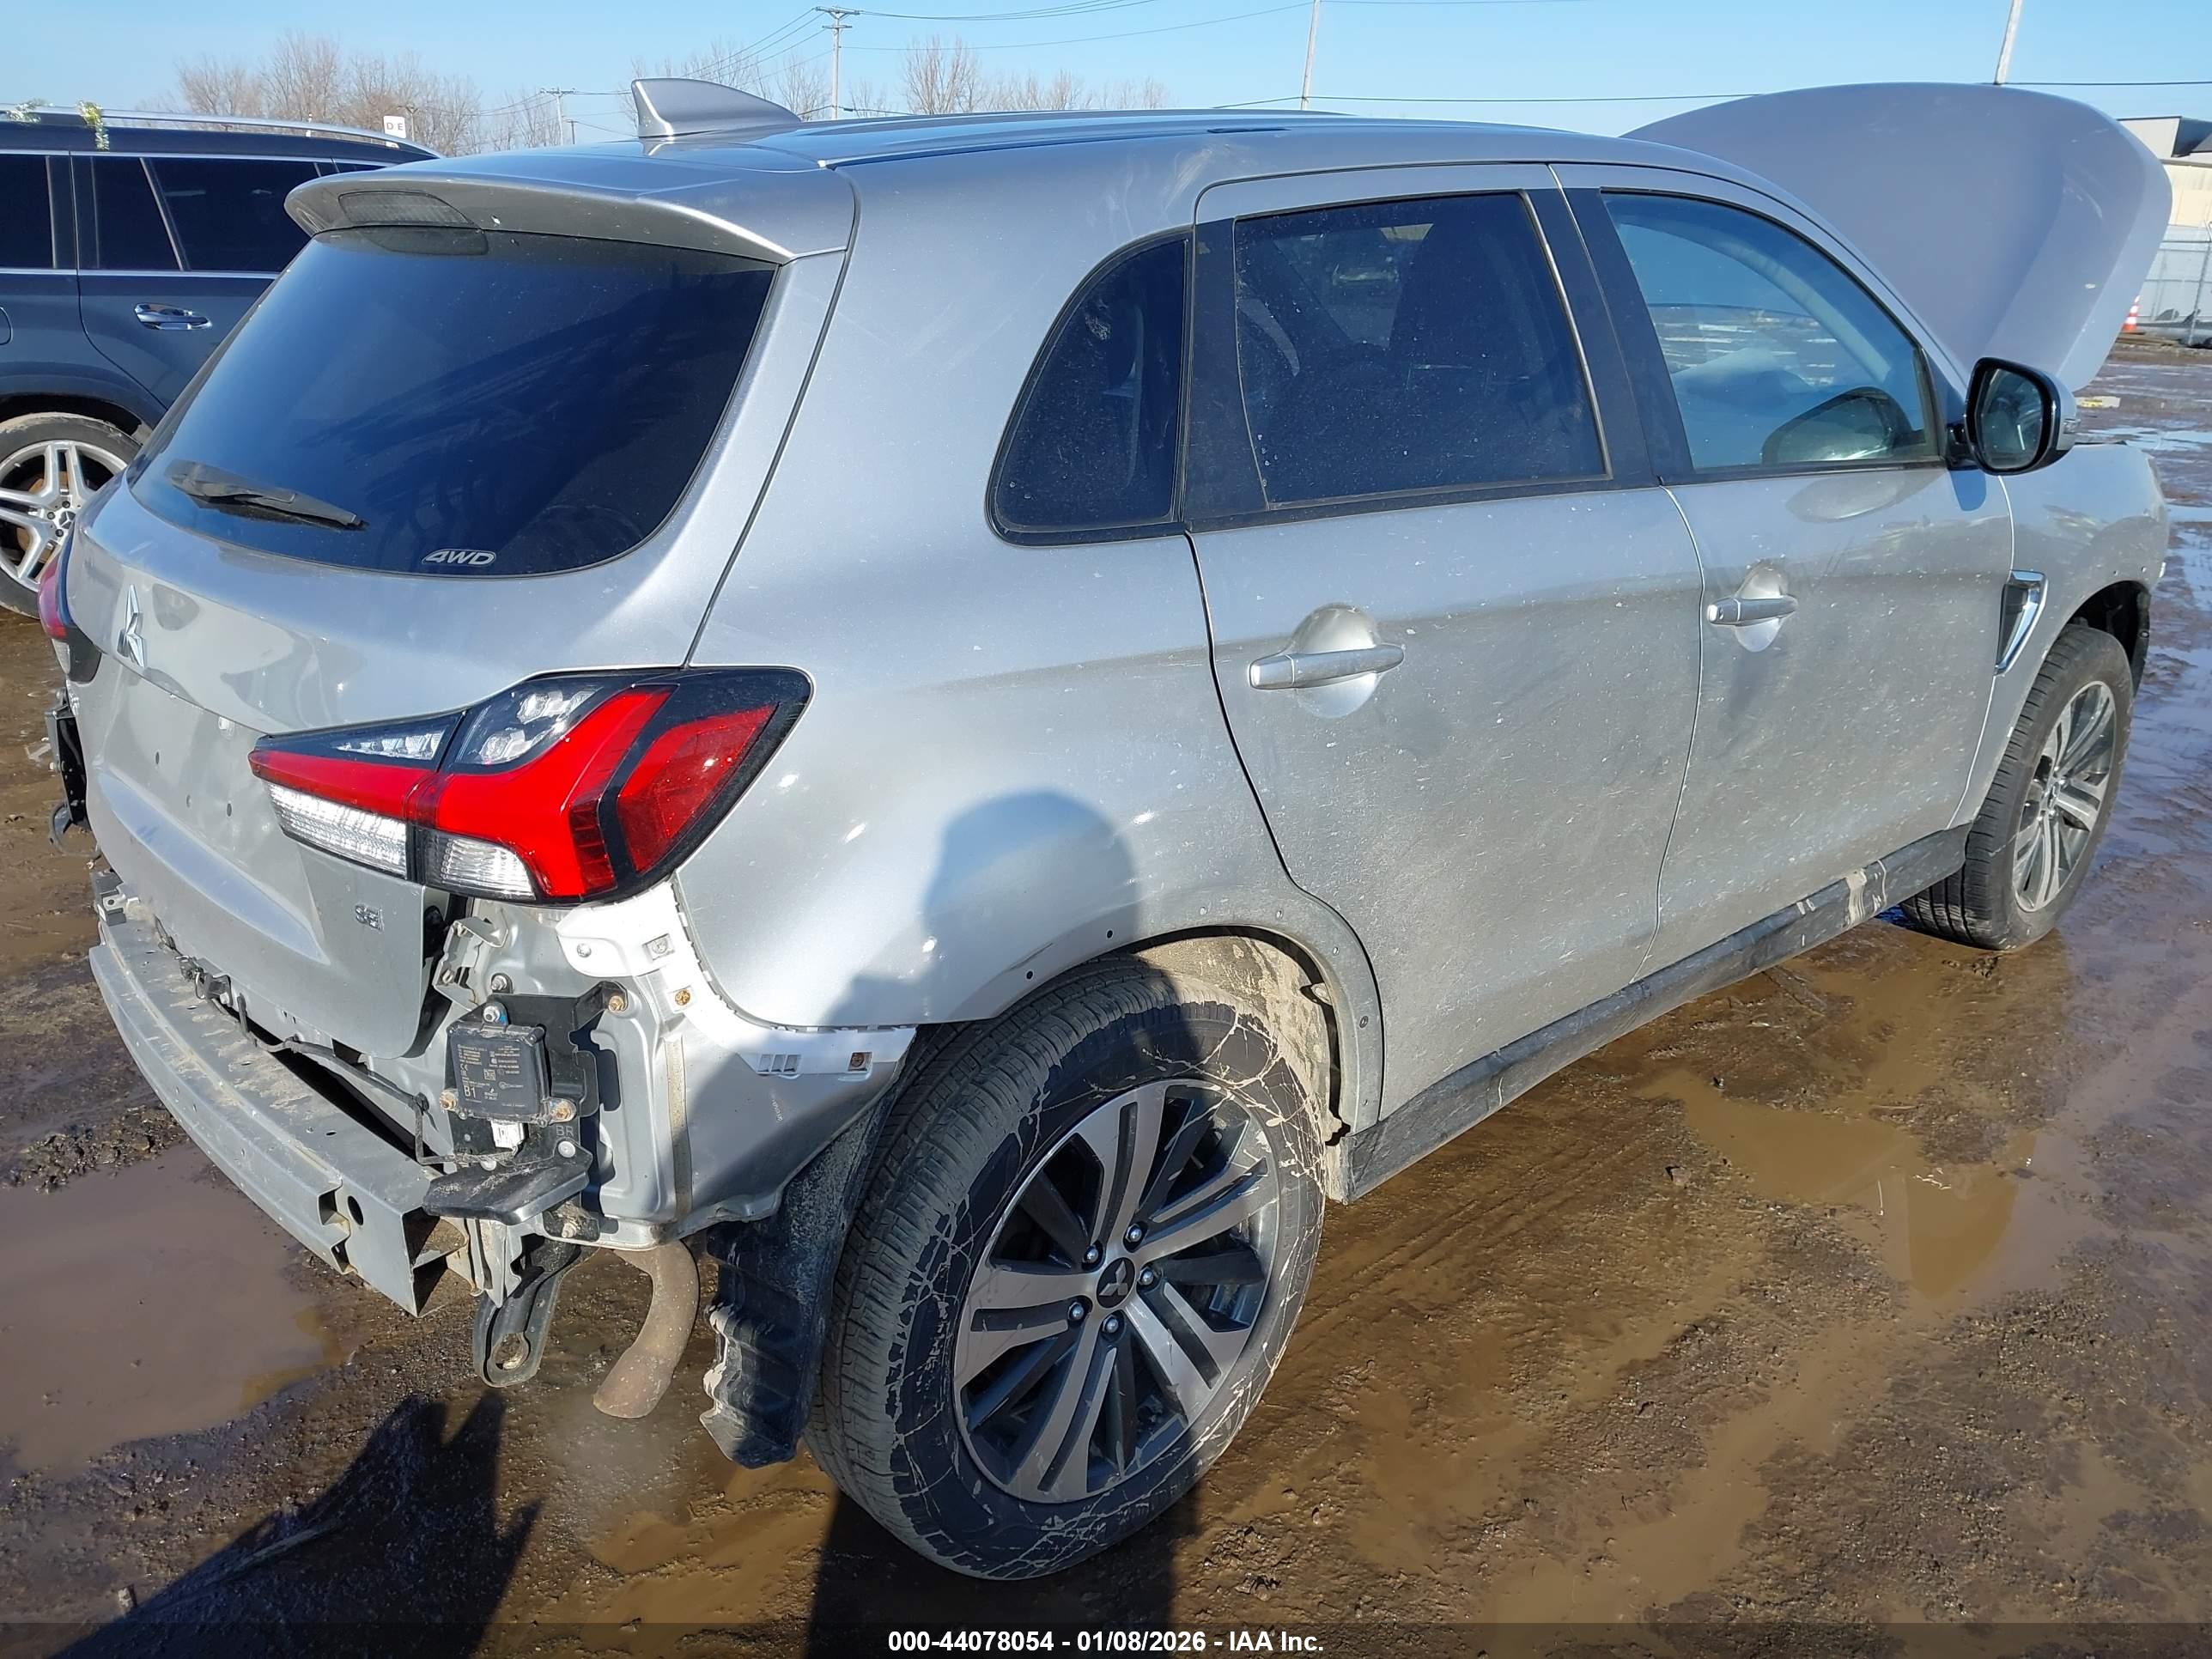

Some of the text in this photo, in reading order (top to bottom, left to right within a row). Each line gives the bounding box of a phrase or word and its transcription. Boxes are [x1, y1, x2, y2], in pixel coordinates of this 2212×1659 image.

[425, 550, 495, 566] 4WD
[464, 1085, 476, 1098] B1
[556, 1125, 574, 1137] BR
